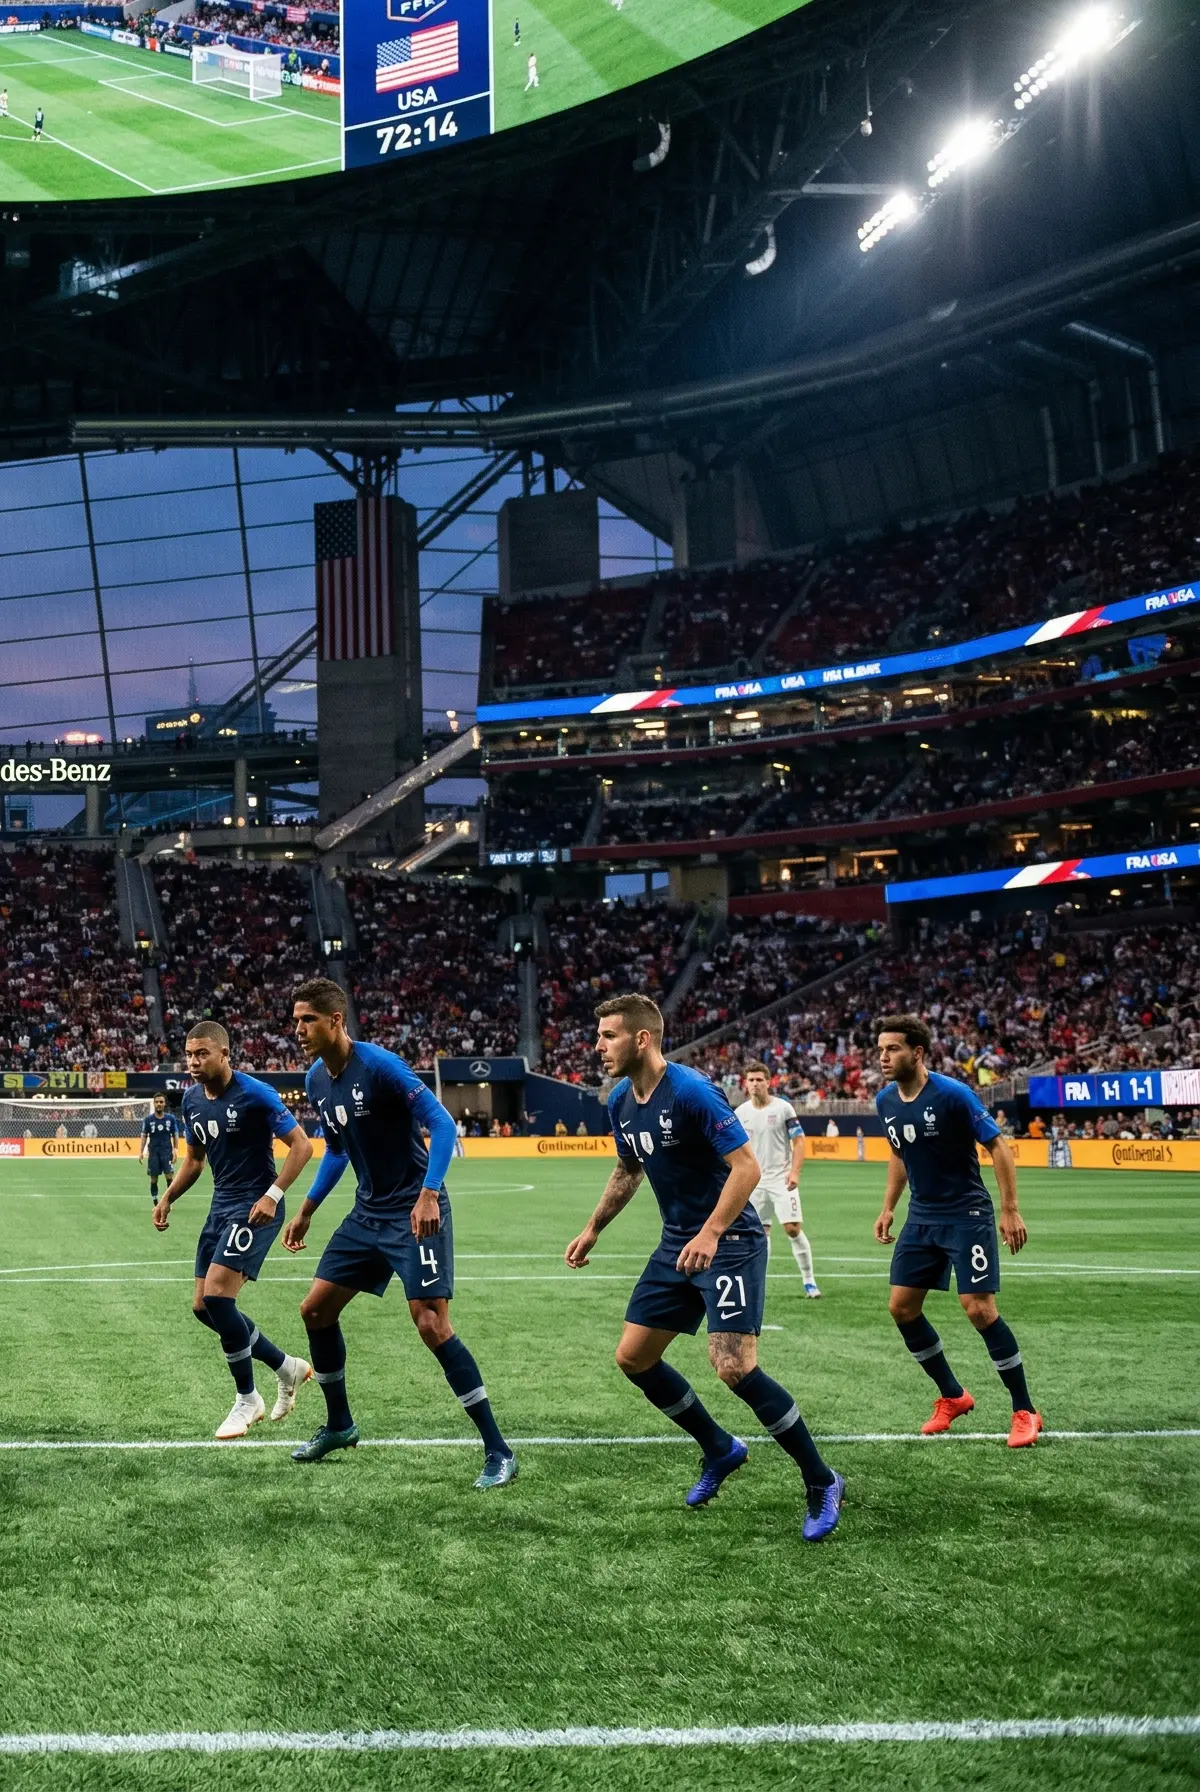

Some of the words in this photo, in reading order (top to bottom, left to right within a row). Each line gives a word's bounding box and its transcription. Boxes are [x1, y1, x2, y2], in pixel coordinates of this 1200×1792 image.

[397, 86, 438, 110] USA
[376, 111, 458, 154] 72:14
[1064, 1081, 1092, 1101] FRA
[1129, 1075, 1153, 1101] 1-1
[42, 1140, 120, 1156] Continental
[887, 1125, 901, 1149] 8
[226, 1223, 254, 1252] 10
[419, 1245, 438, 1274] 4
[970, 1244, 988, 1272] 8
[715, 1275, 747, 1307] 21
